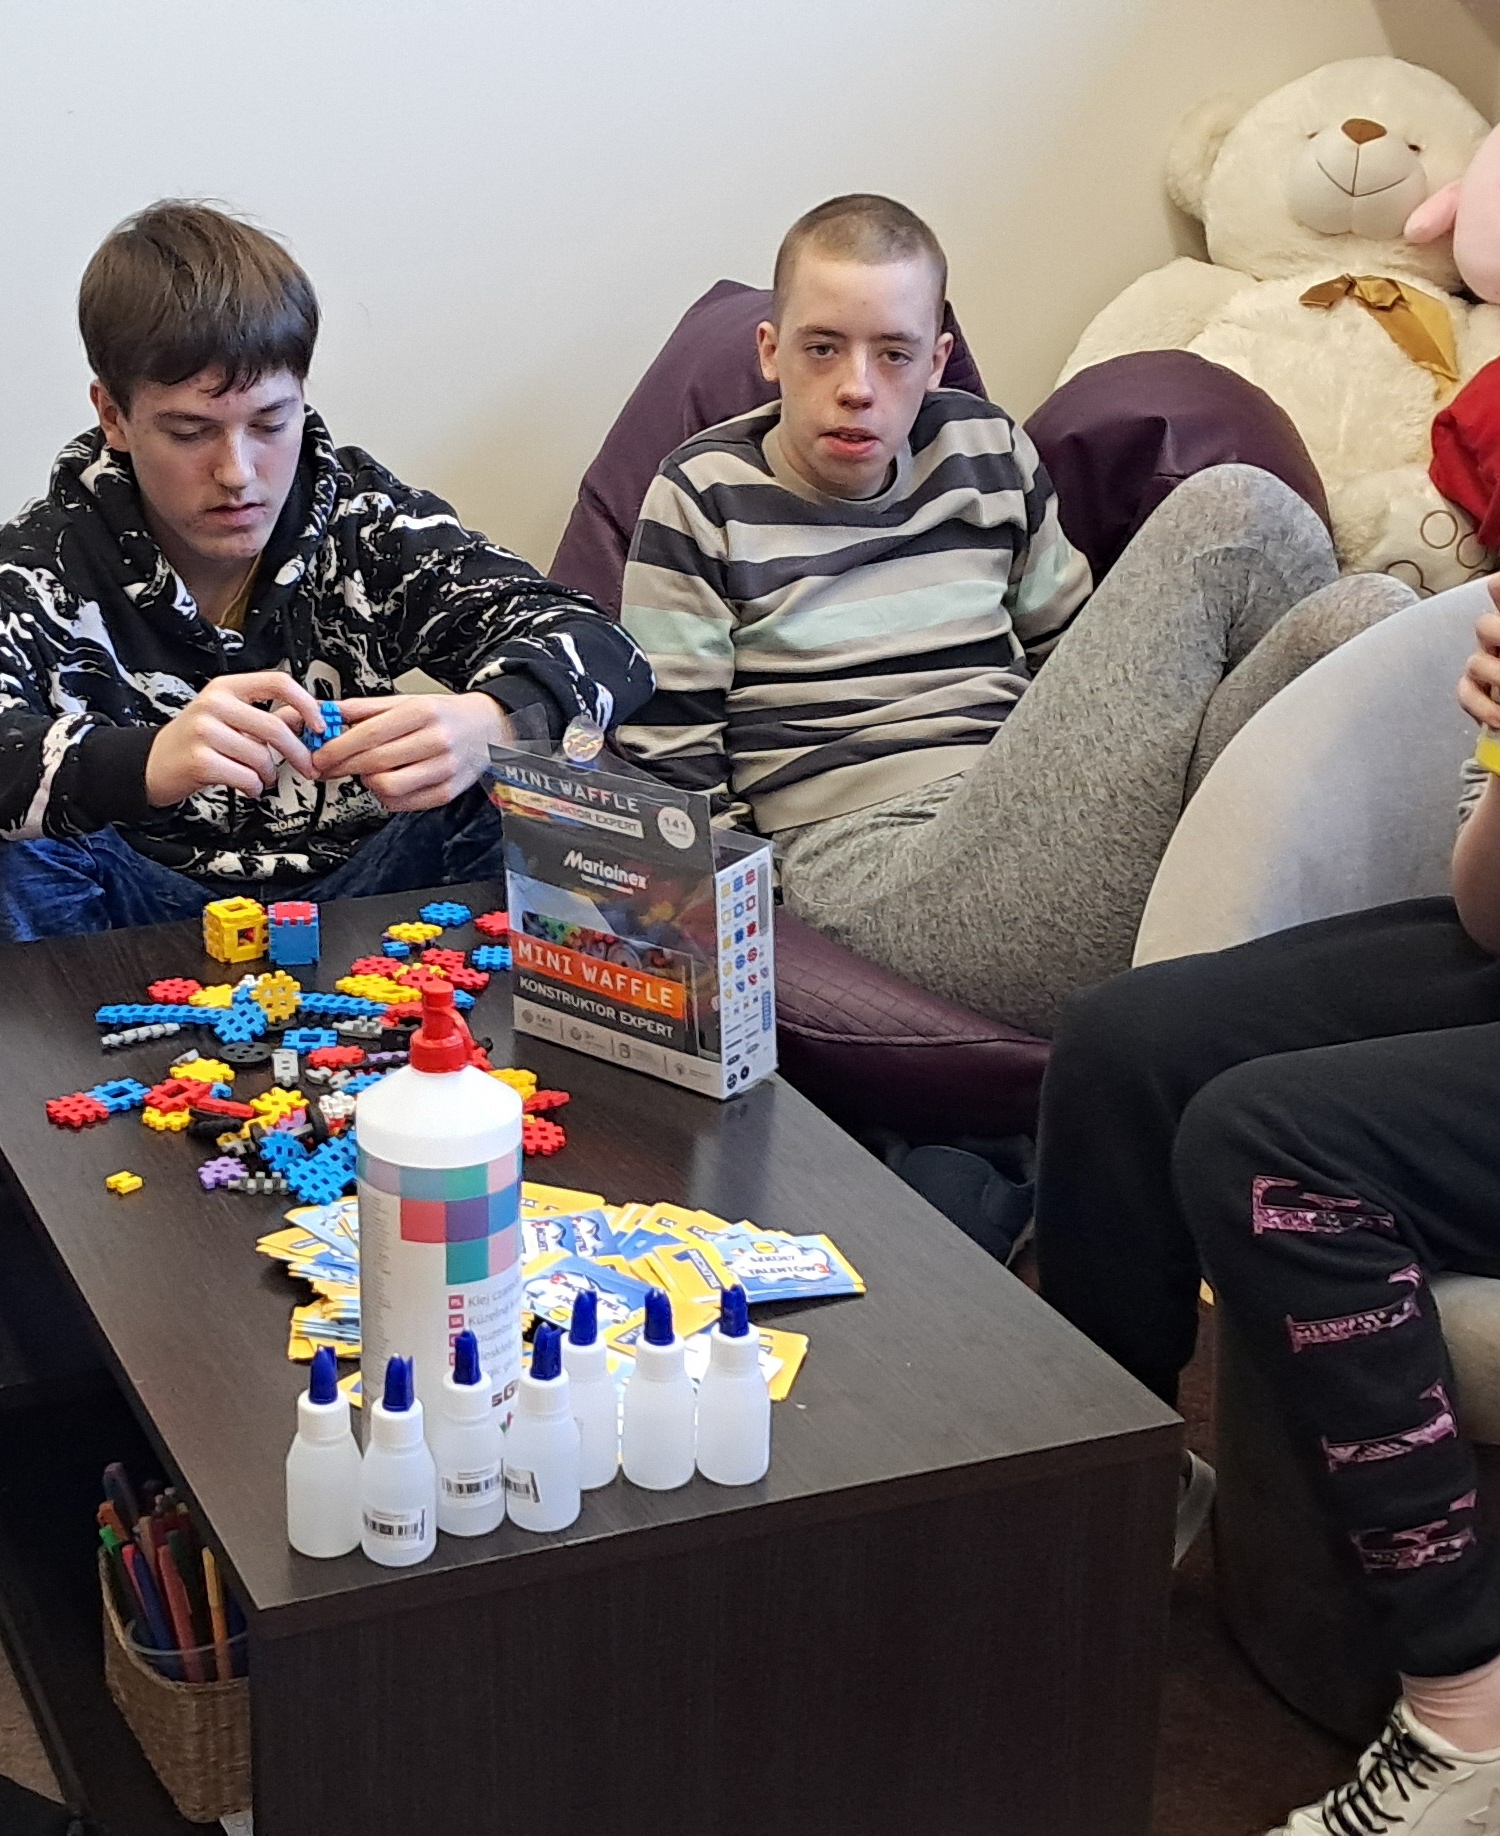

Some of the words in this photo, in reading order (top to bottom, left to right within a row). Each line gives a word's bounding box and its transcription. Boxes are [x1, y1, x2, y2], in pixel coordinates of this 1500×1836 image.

[504, 766, 552, 790] MINI
[560, 780, 640, 813] WAFFLE
[563, 849, 649, 890] Marioinex
[518, 940, 573, 976] MINI
[581, 962, 674, 1008] WAFFLE
[519, 975, 617, 1021] KONSTRUKTOR
[619, 1011, 674, 1040] EXPERT
